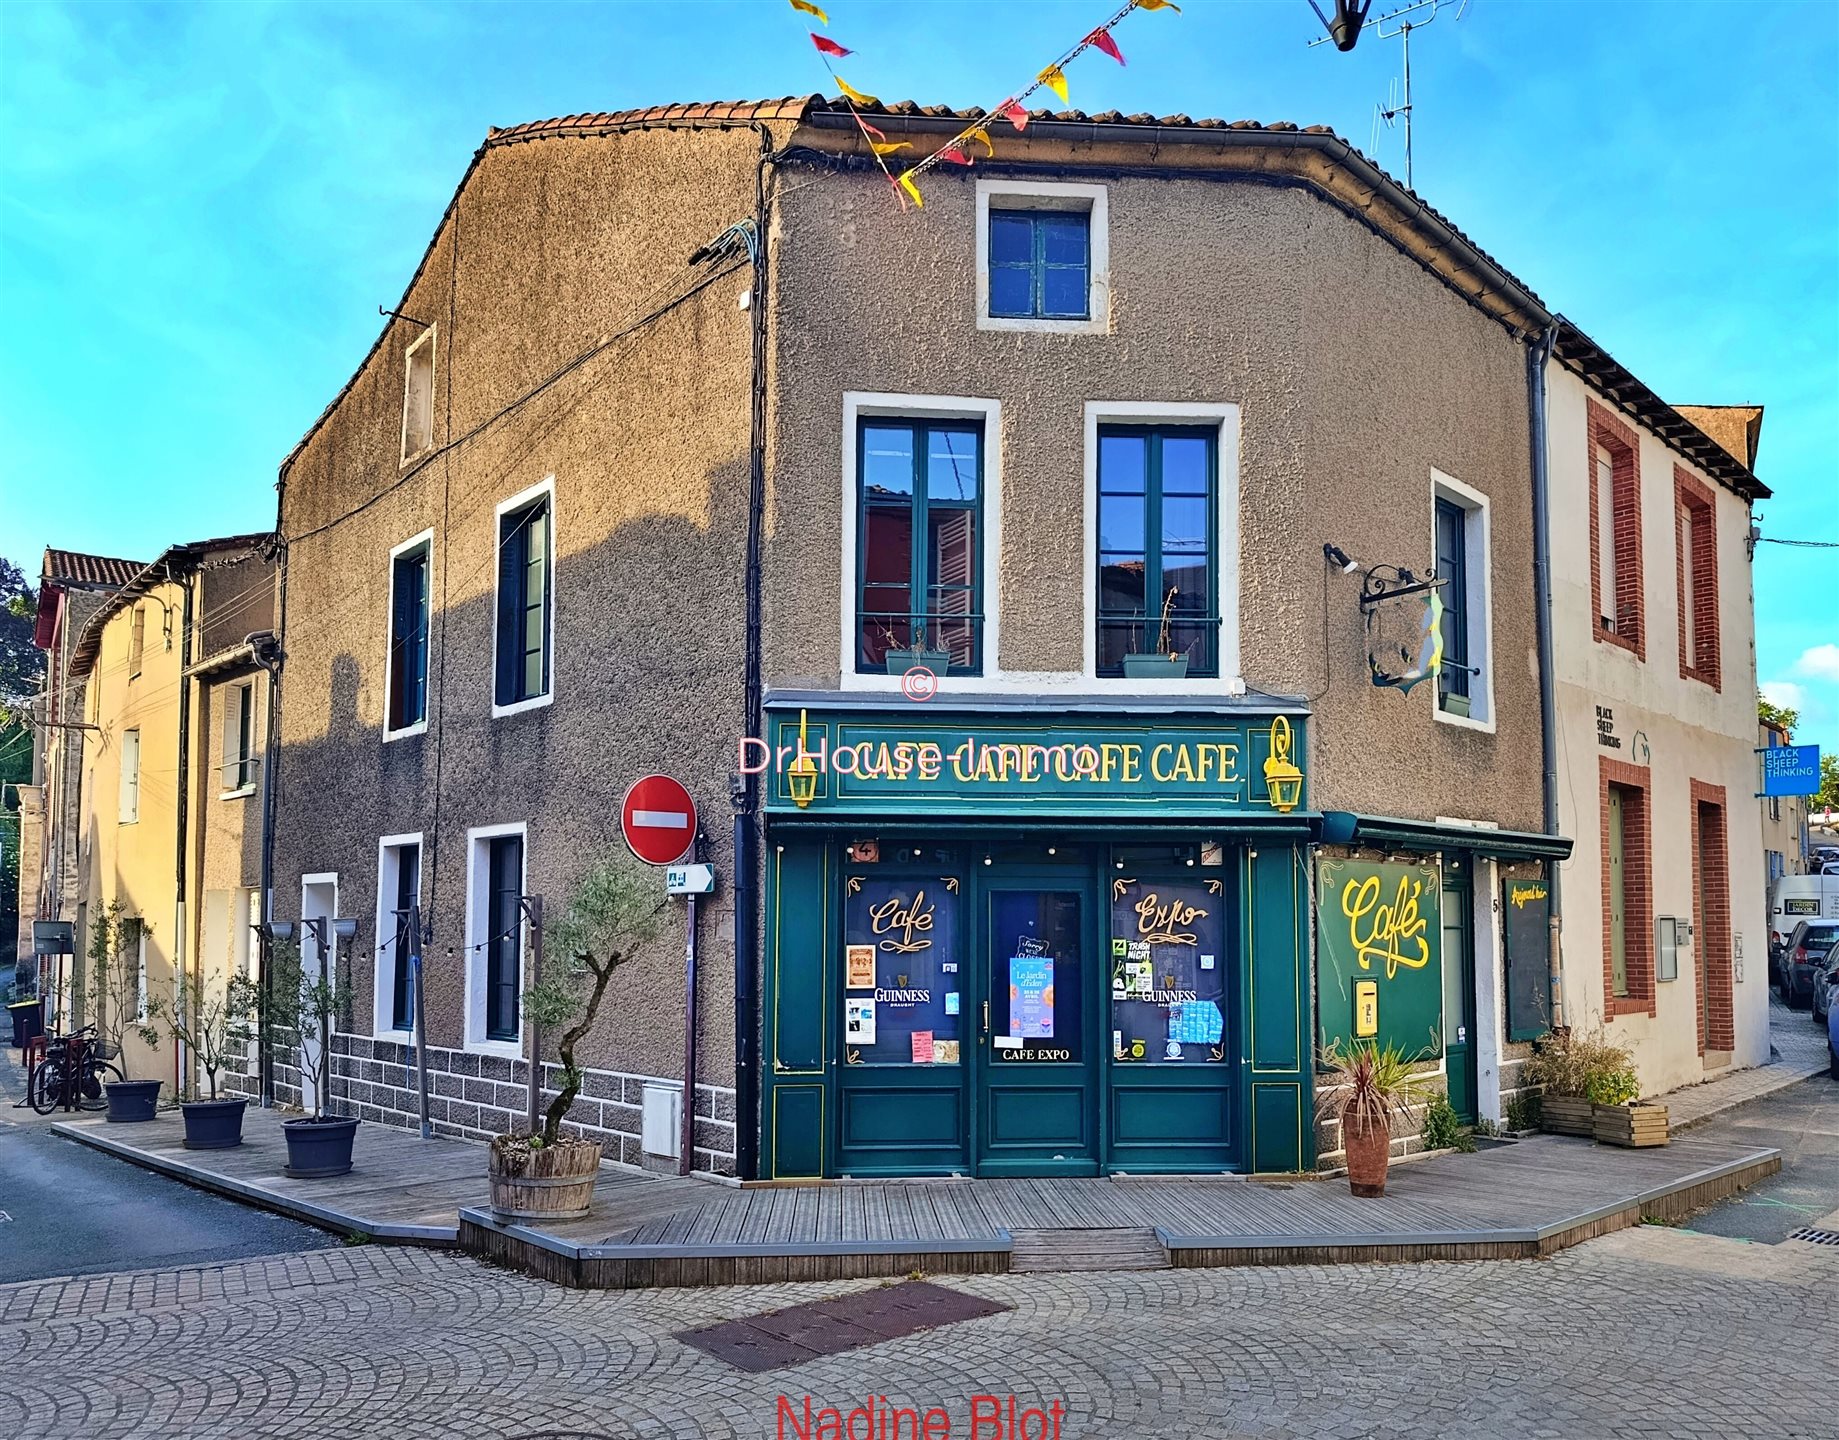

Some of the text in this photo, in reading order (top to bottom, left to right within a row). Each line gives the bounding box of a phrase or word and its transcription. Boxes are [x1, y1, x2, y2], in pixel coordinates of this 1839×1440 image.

[1766, 749, 1799, 759] BLACK
[1054, 743, 1143, 782] CAFE
[1766, 758, 1799, 768] SHEEP
[1766, 766, 1814, 778] THINKING
[1492, 898, 1498, 912] 5
[869, 890, 935, 945] Café
[1135, 893, 1209, 934] Expo
[1342, 875, 1427, 980] Café
[874, 988, 930, 1003] GUINNESS
[1142, 990, 1197, 1002] GUINNESS
[1002, 1049, 1070, 1060] CAFE EXPO
